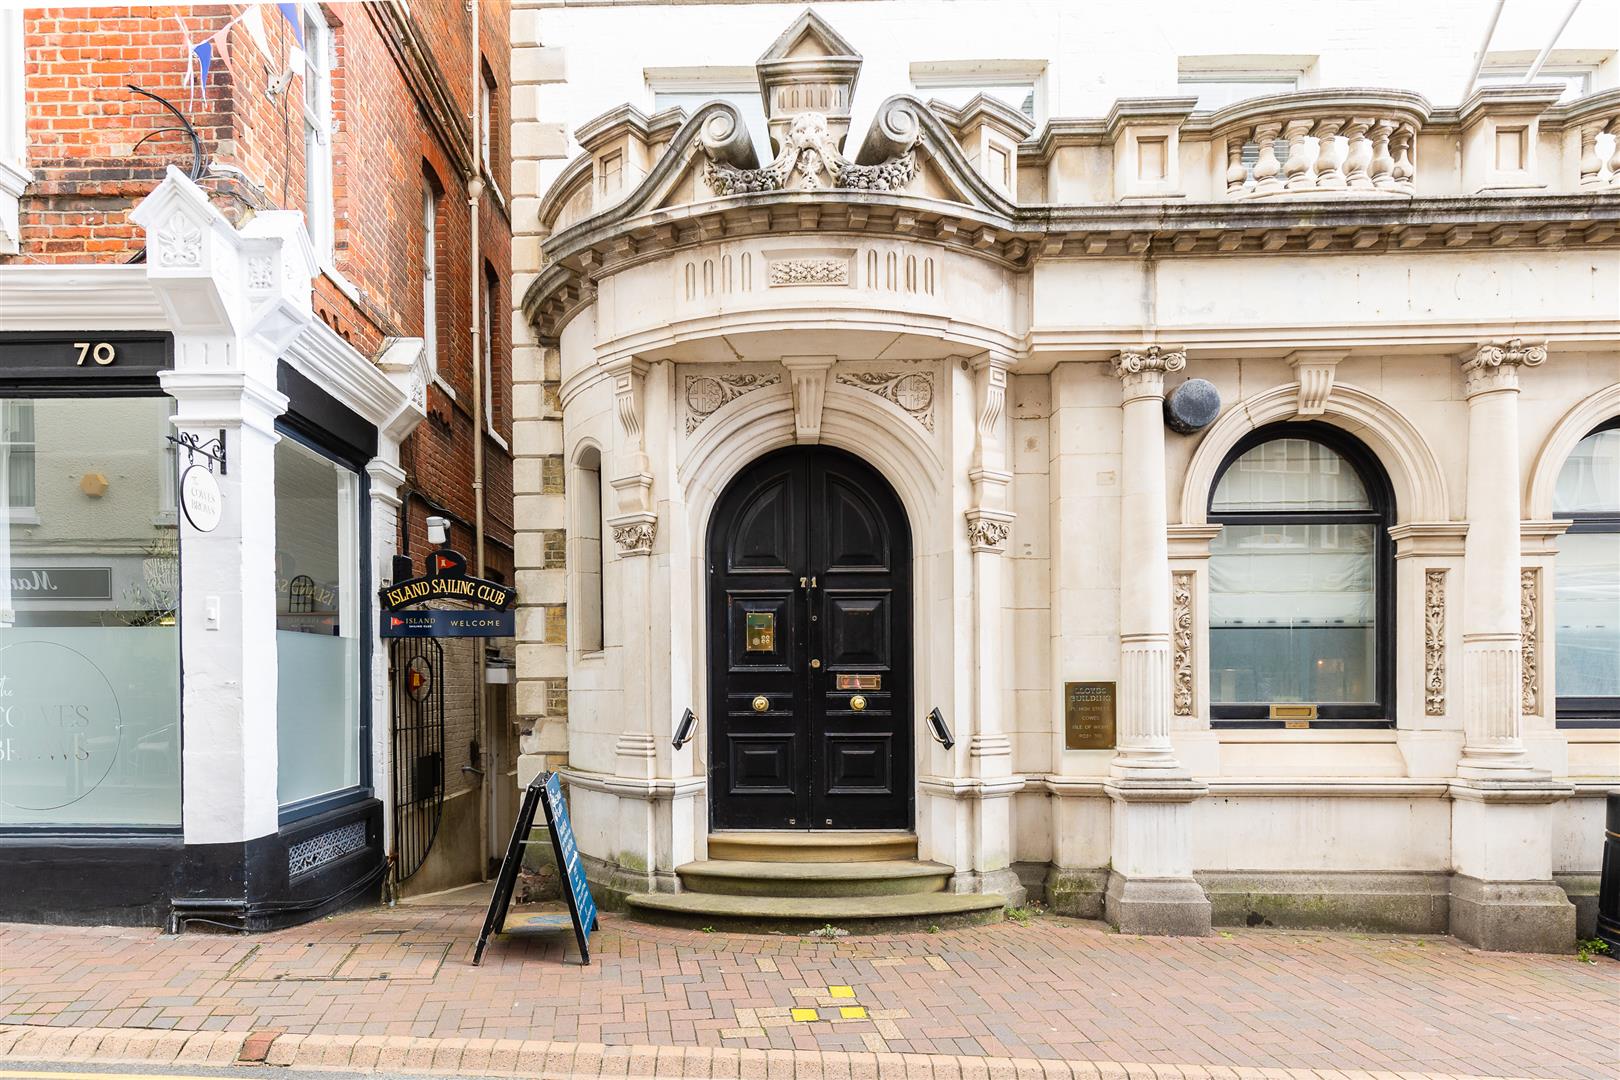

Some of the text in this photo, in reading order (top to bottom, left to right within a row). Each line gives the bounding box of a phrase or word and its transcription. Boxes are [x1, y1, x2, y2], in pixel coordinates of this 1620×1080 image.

[73, 342, 115, 366] 70
[800, 576, 817, 588] 71
[387, 578, 506, 607] ISLAND SAILING CLUB
[405, 617, 436, 625] ISLAND
[450, 619, 501, 628] WELCOME
